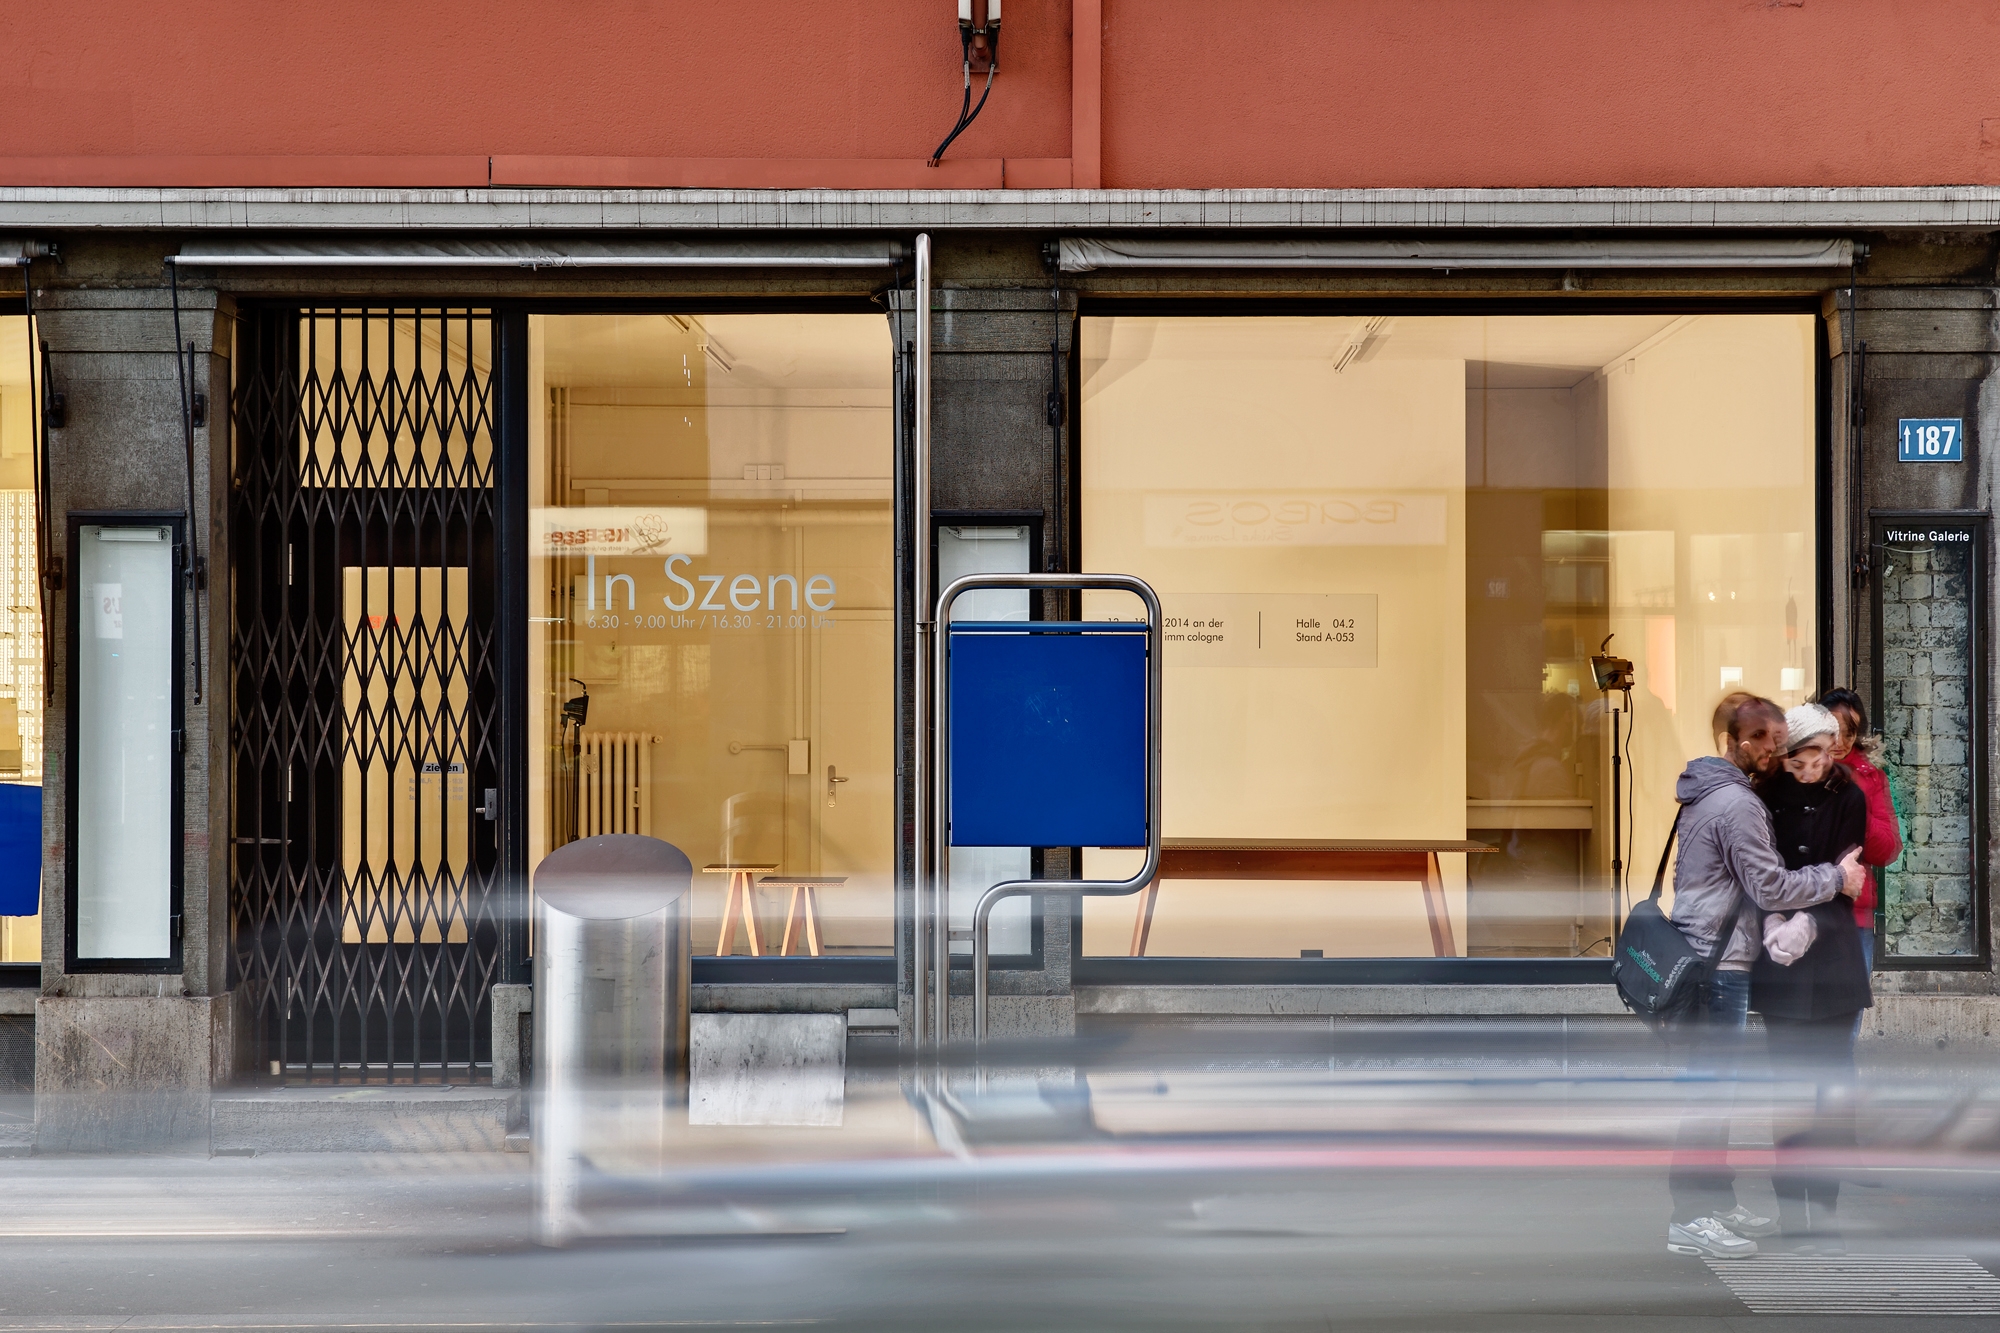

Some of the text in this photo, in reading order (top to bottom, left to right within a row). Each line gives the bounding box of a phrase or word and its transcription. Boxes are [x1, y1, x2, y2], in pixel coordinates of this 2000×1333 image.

[1916, 426, 1956, 455] 187
[1887, 530, 1970, 542] Vitrine Galerie
[588, 553, 837, 612] In Szene
[588, 615, 620, 629] 6.30
[634, 615, 666, 629] 9.00
[670, 614, 696, 629] Uhr
[712, 615, 751, 629] 16.30
[766, 615, 807, 629] 21.00
[811, 614, 836, 629] Uhr
[1193, 620, 1205, 628] an
[1208, 618, 1224, 628] der
[1296, 618, 1355, 628] Halle 04.2
[1164, 631, 1224, 644] imm cologne
[1296, 632, 1355, 642] Stand A-053
[426, 763, 459, 772] zieen
